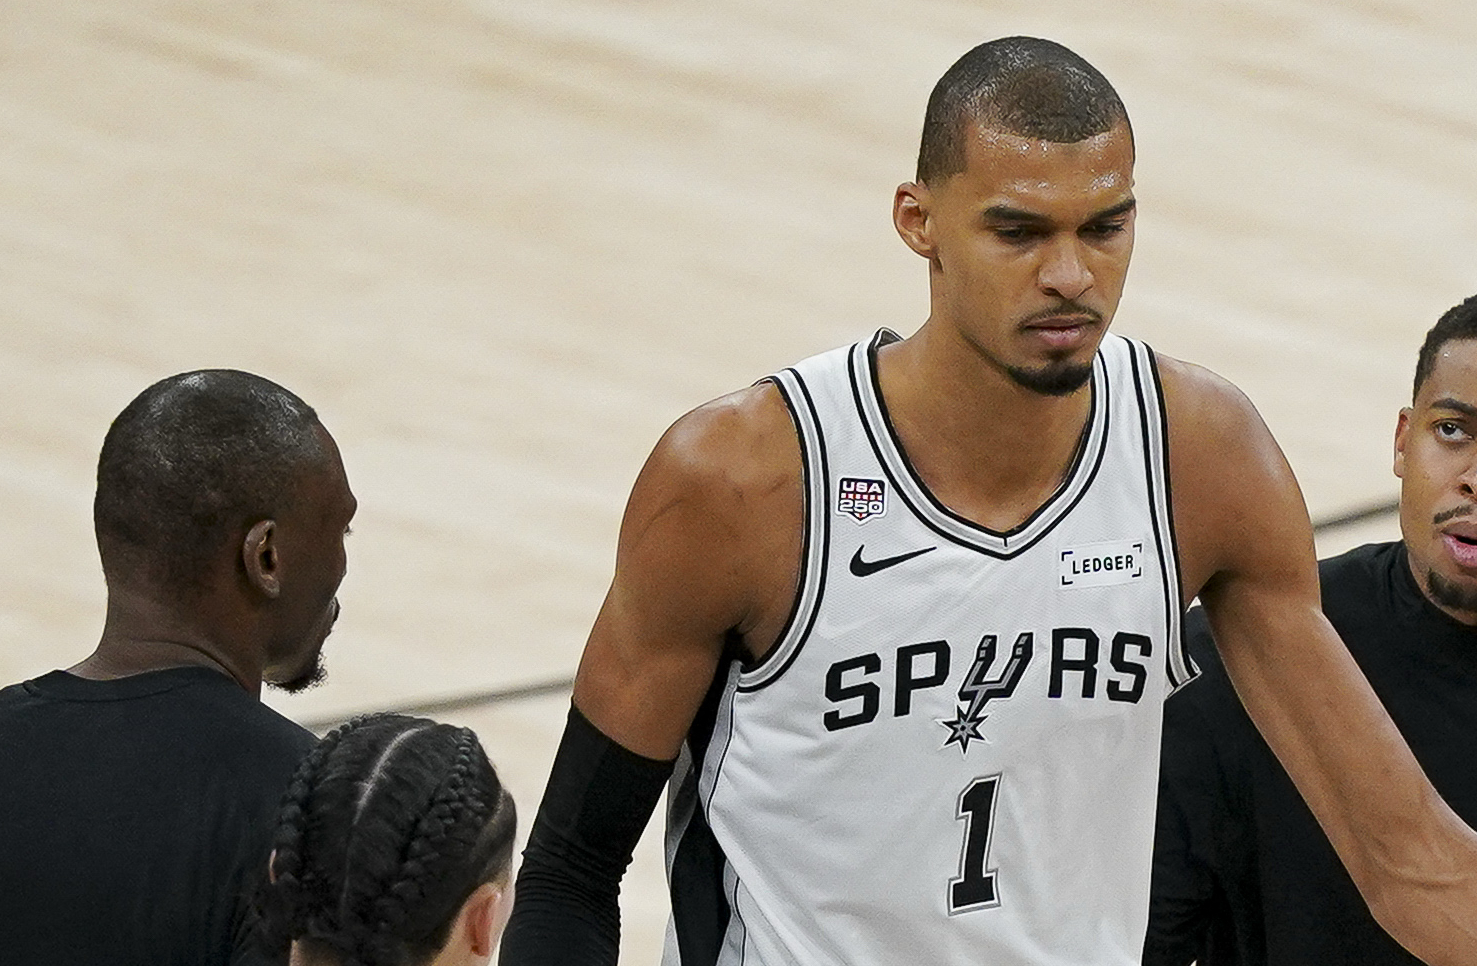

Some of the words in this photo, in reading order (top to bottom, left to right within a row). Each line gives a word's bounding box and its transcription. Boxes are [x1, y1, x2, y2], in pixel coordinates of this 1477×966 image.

[842, 480, 882, 493] USA
[839, 499, 883, 514] 250
[1072, 554, 1134, 575] LEDGER
[823, 628, 1152, 754] SPURS
[947, 771, 1003, 916] 1
